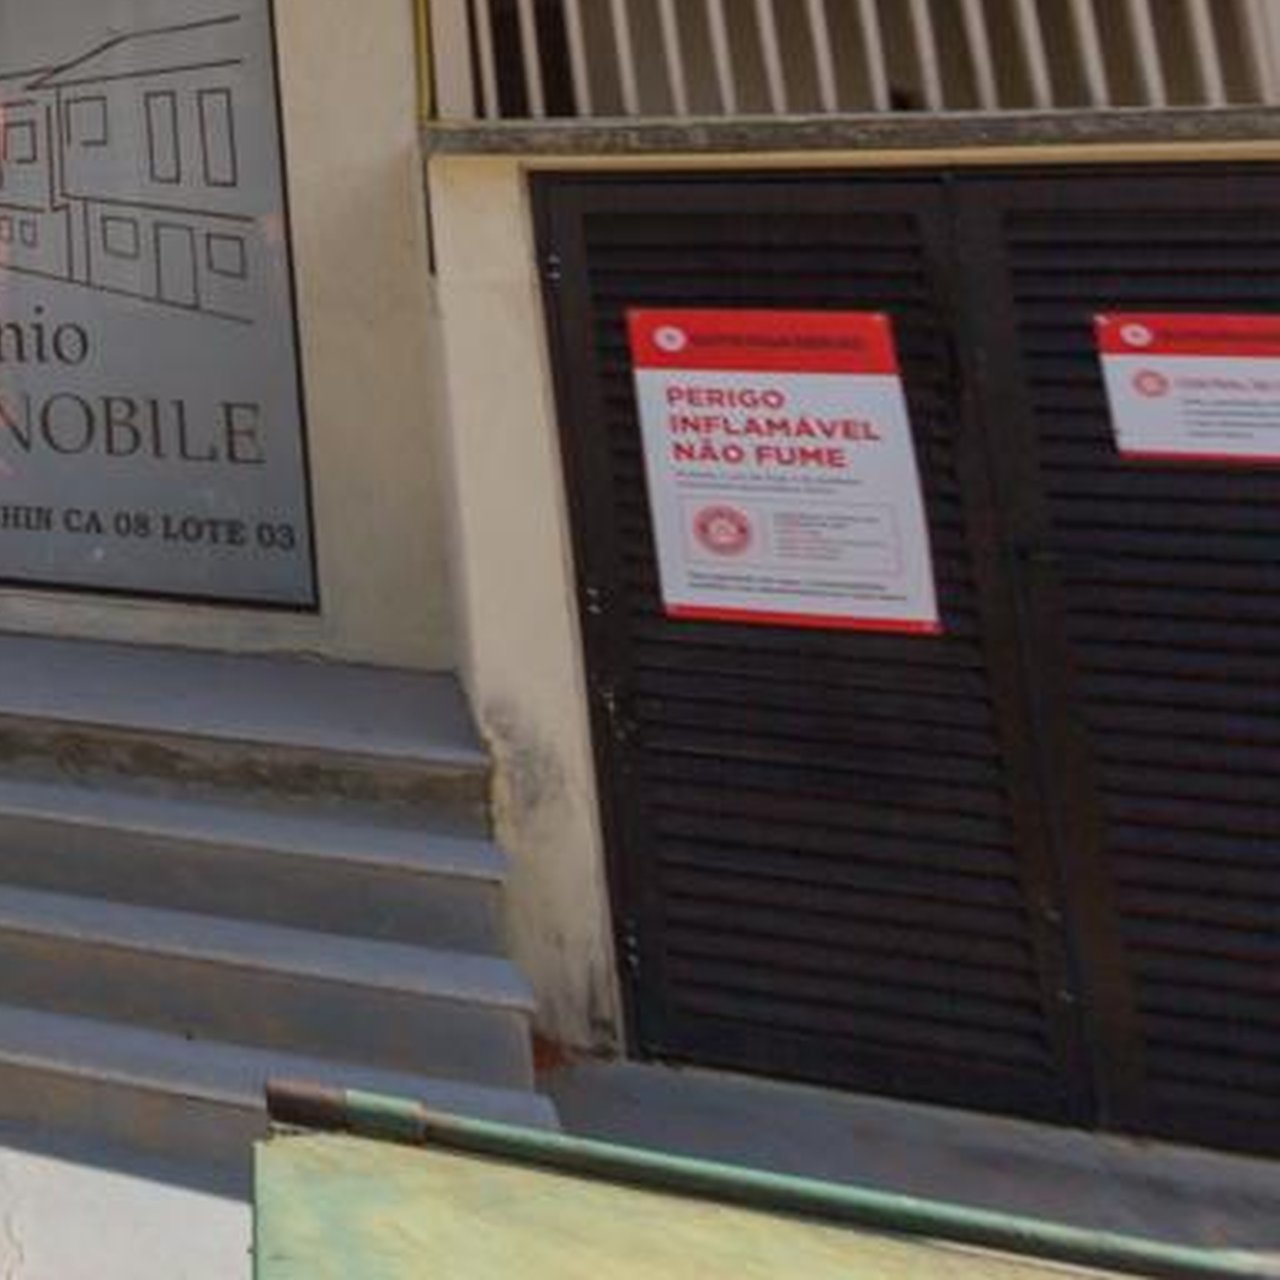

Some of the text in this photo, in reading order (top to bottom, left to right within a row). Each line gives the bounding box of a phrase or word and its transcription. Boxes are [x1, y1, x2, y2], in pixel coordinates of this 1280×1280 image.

[665, 386, 786, 410] PERIGO
[672, 437, 848, 468] NÃO FUME
[62, 508, 103, 535] CA
[113, 512, 149, 539] 08
[161, 516, 246, 547] LOTE
[254, 523, 296, 551] 03
